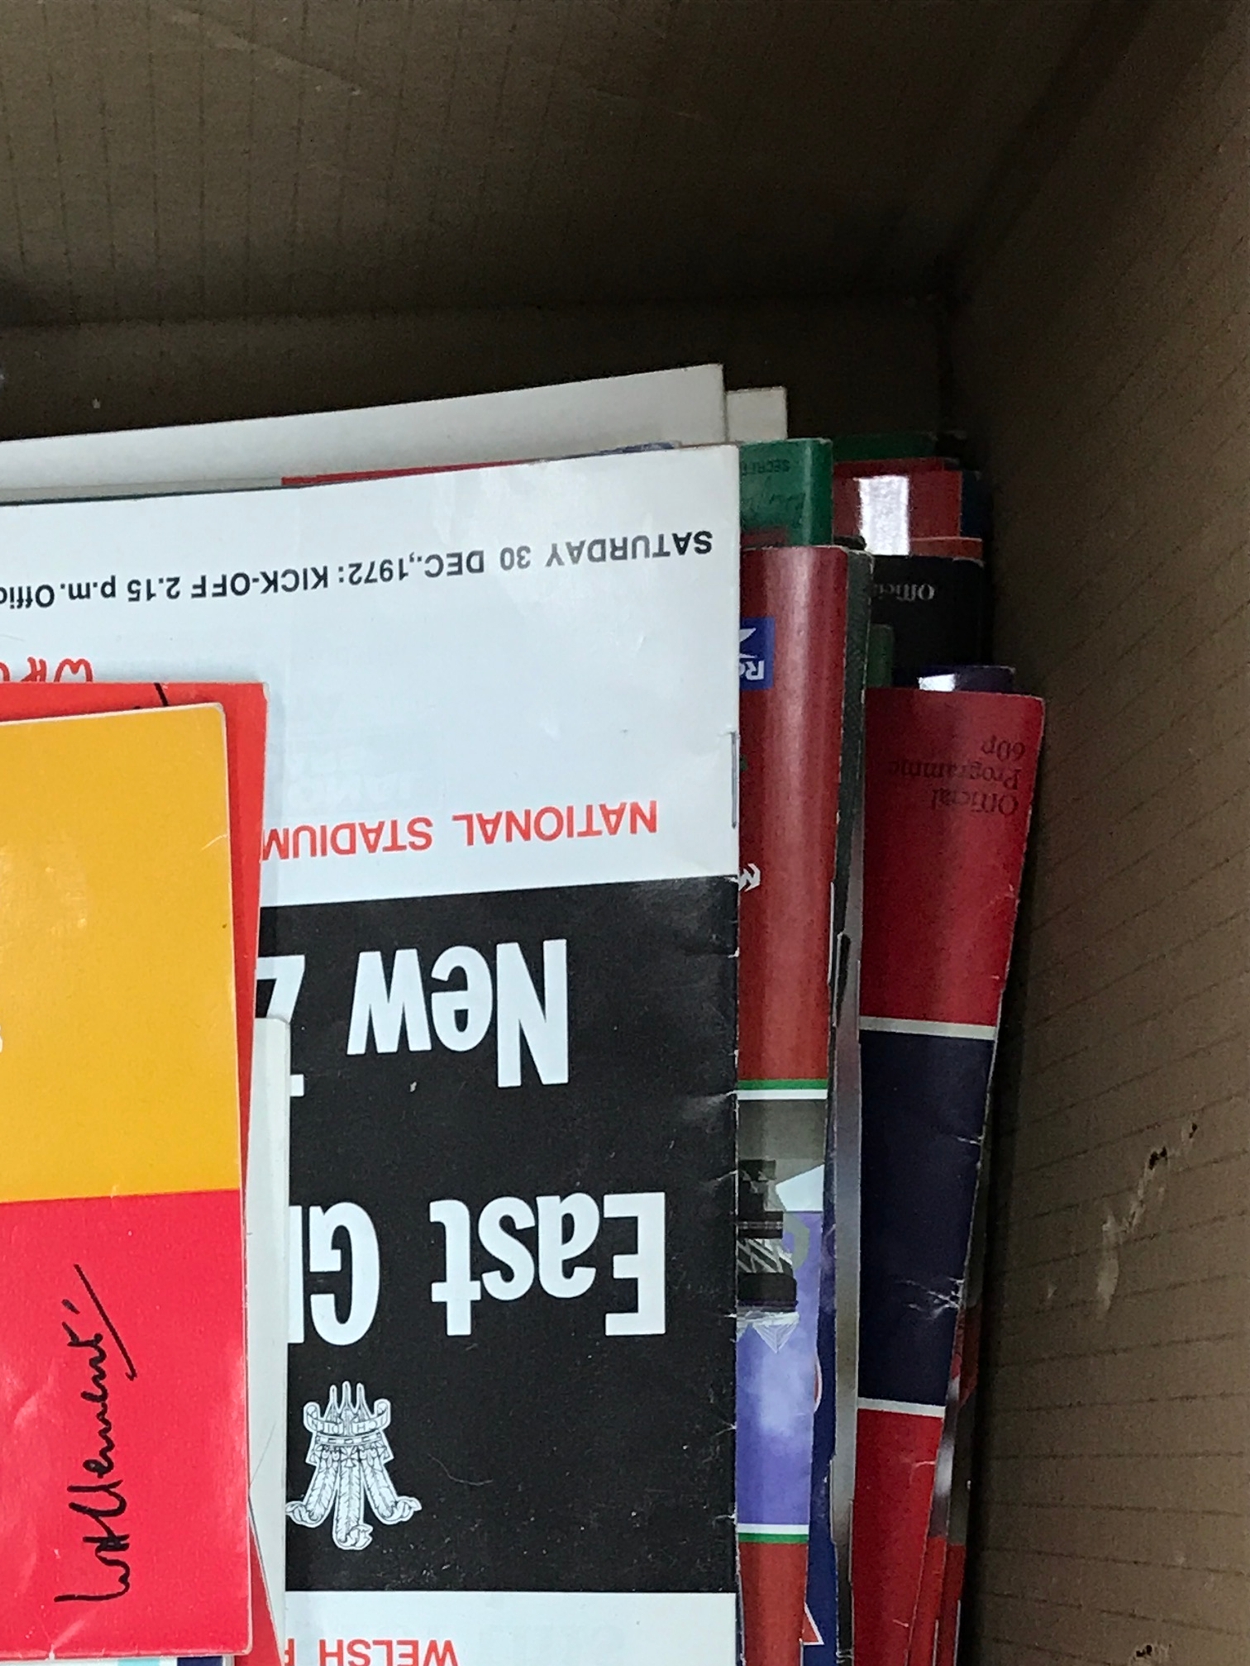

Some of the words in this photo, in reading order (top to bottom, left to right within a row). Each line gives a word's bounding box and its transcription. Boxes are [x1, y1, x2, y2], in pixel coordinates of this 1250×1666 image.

[500, 546, 531, 569] 30
[545, 530, 713, 567] SATURDAY
[127, 576, 181, 601] 2.15
[191, 565, 328, 599] KICK-OFF
[932, 788, 1019, 817] Official
[262, 816, 432, 861] STADIUM
[453, 800, 658, 846] NATIONAL
[347, 939, 568, 1088] New
[430, 1192, 665, 1336] East
